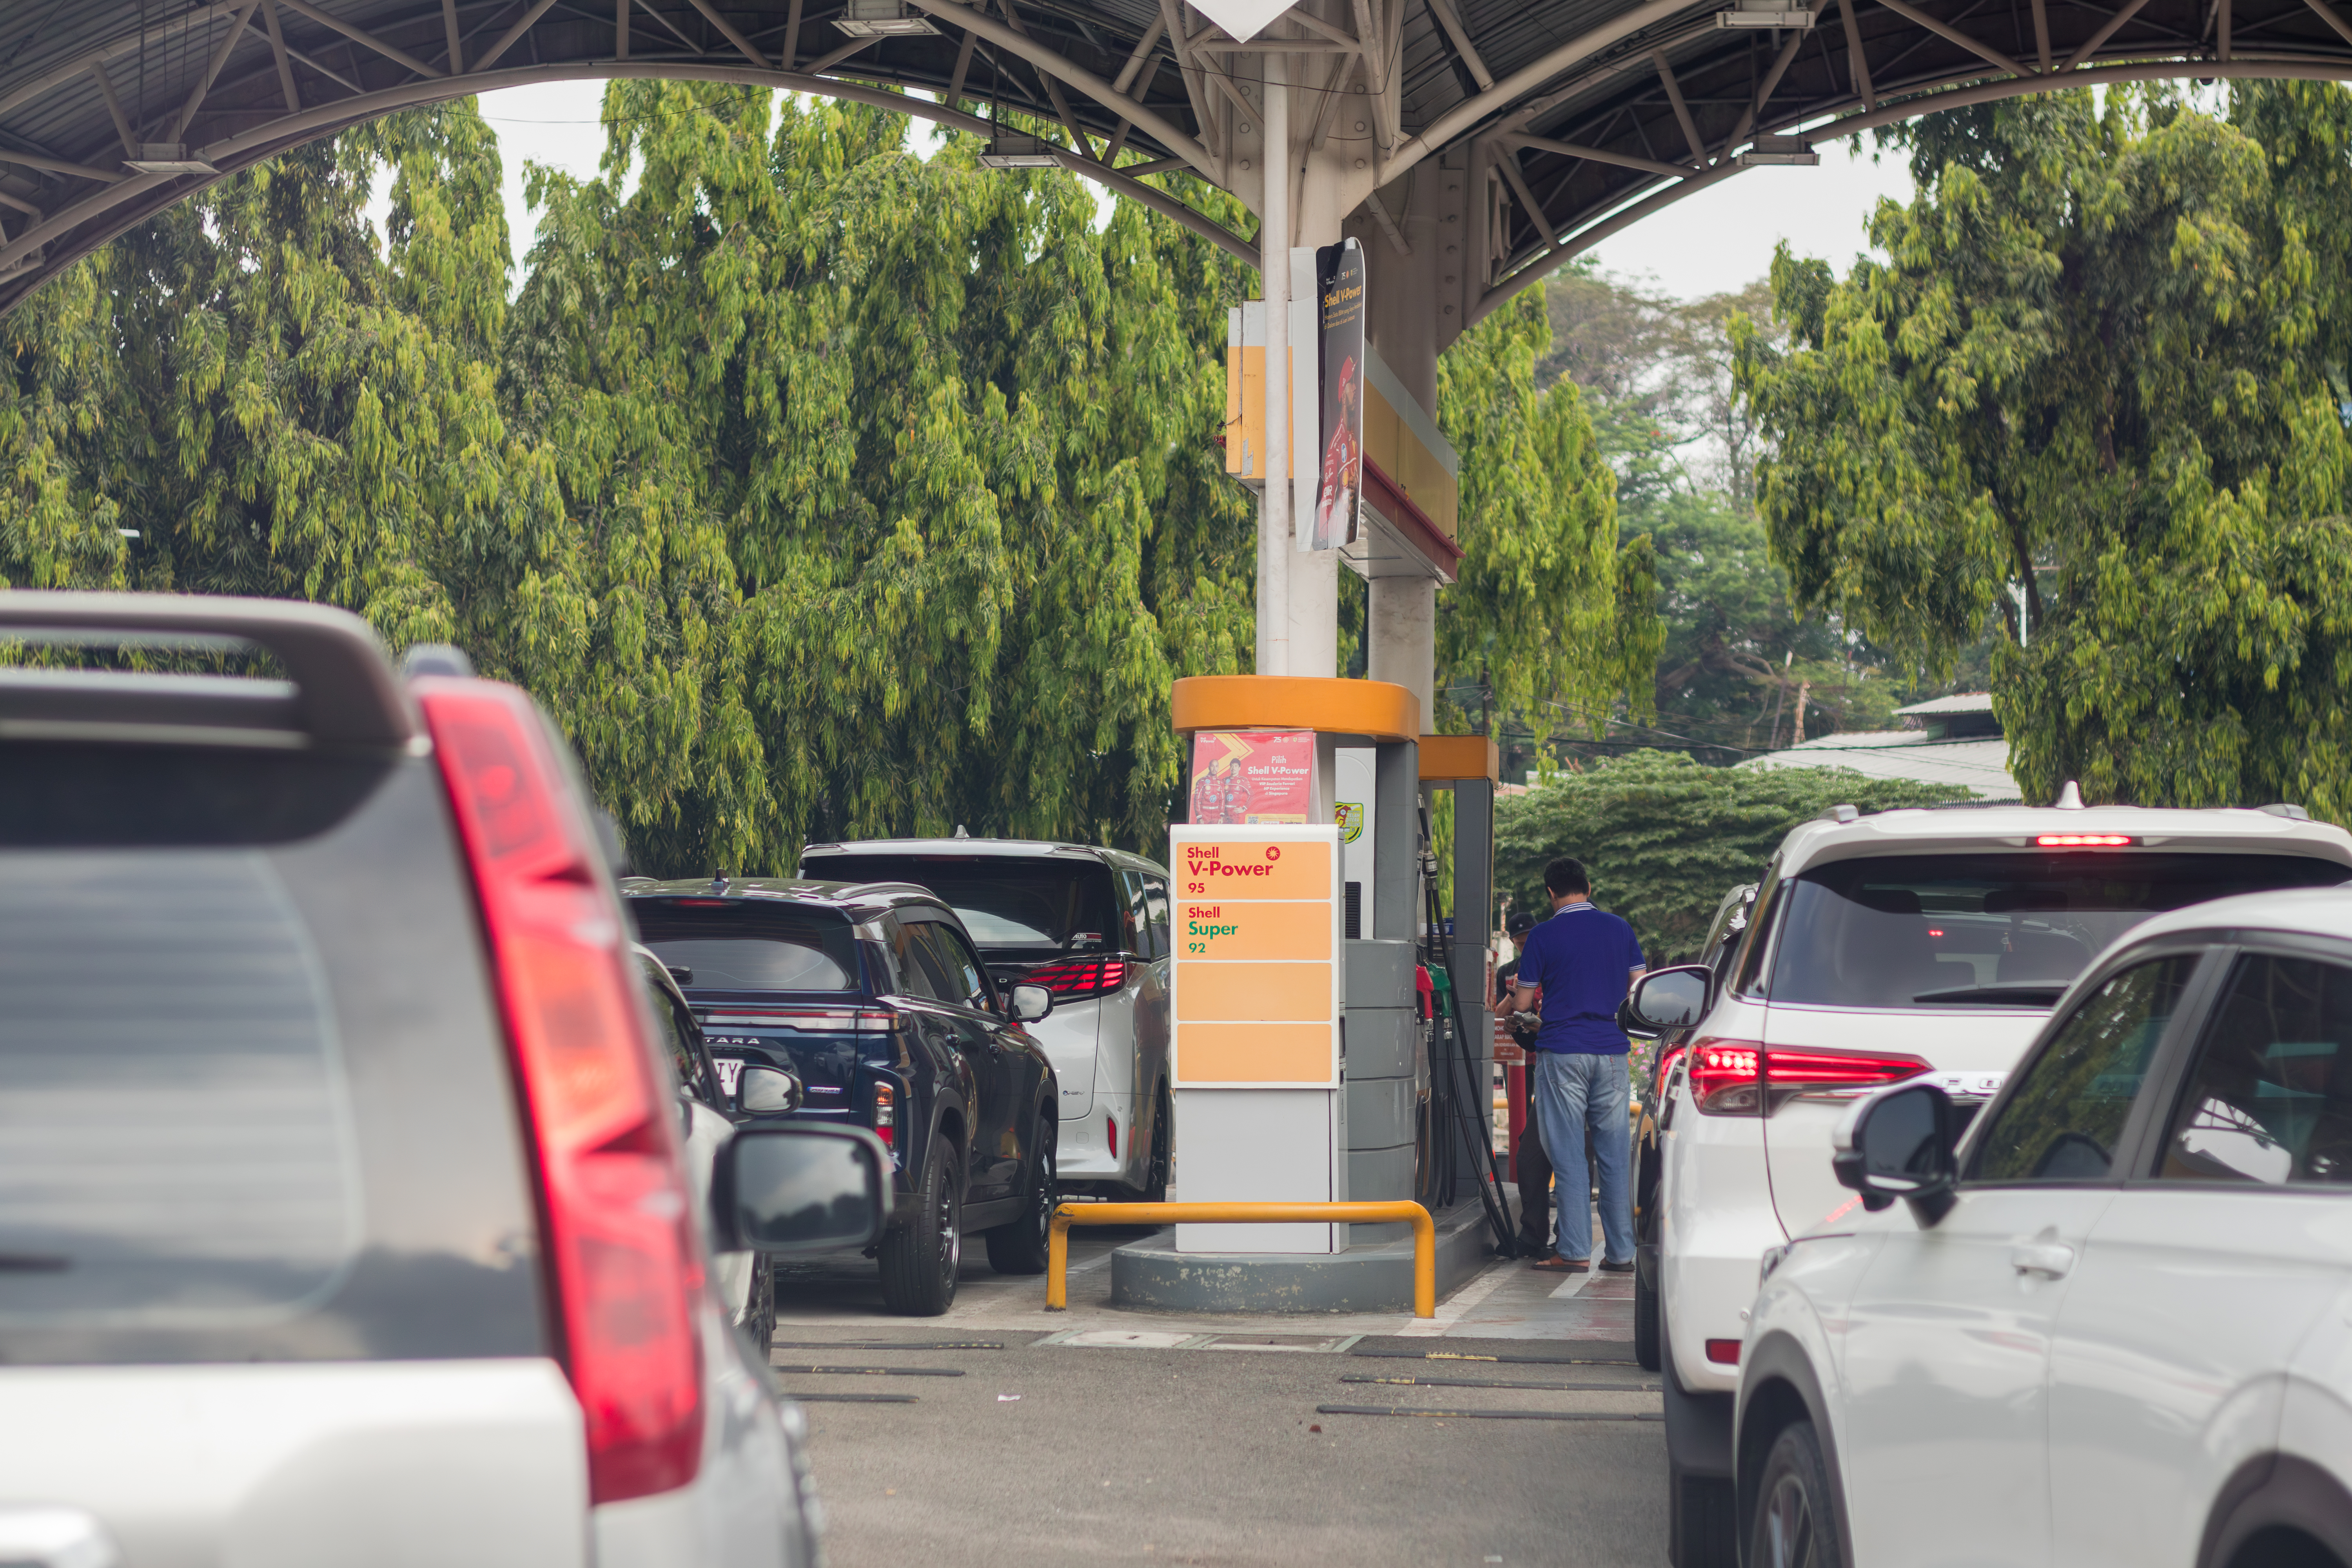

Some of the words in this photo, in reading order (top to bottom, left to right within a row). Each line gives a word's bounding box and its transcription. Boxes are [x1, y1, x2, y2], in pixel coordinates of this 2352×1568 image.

[1325, 290, 1339, 308] Shell
[1341, 285, 1361, 302] V-Power
[1248, 766, 1269, 774] Shell
[1187, 847, 1219, 858] Shell
[1188, 861, 1273, 876] V-Power
[1188, 883, 1205, 893] 95
[1189, 906, 1220, 918] Shell
[1189, 921, 1238, 940] Super
[1189, 943, 1205, 953] 92
